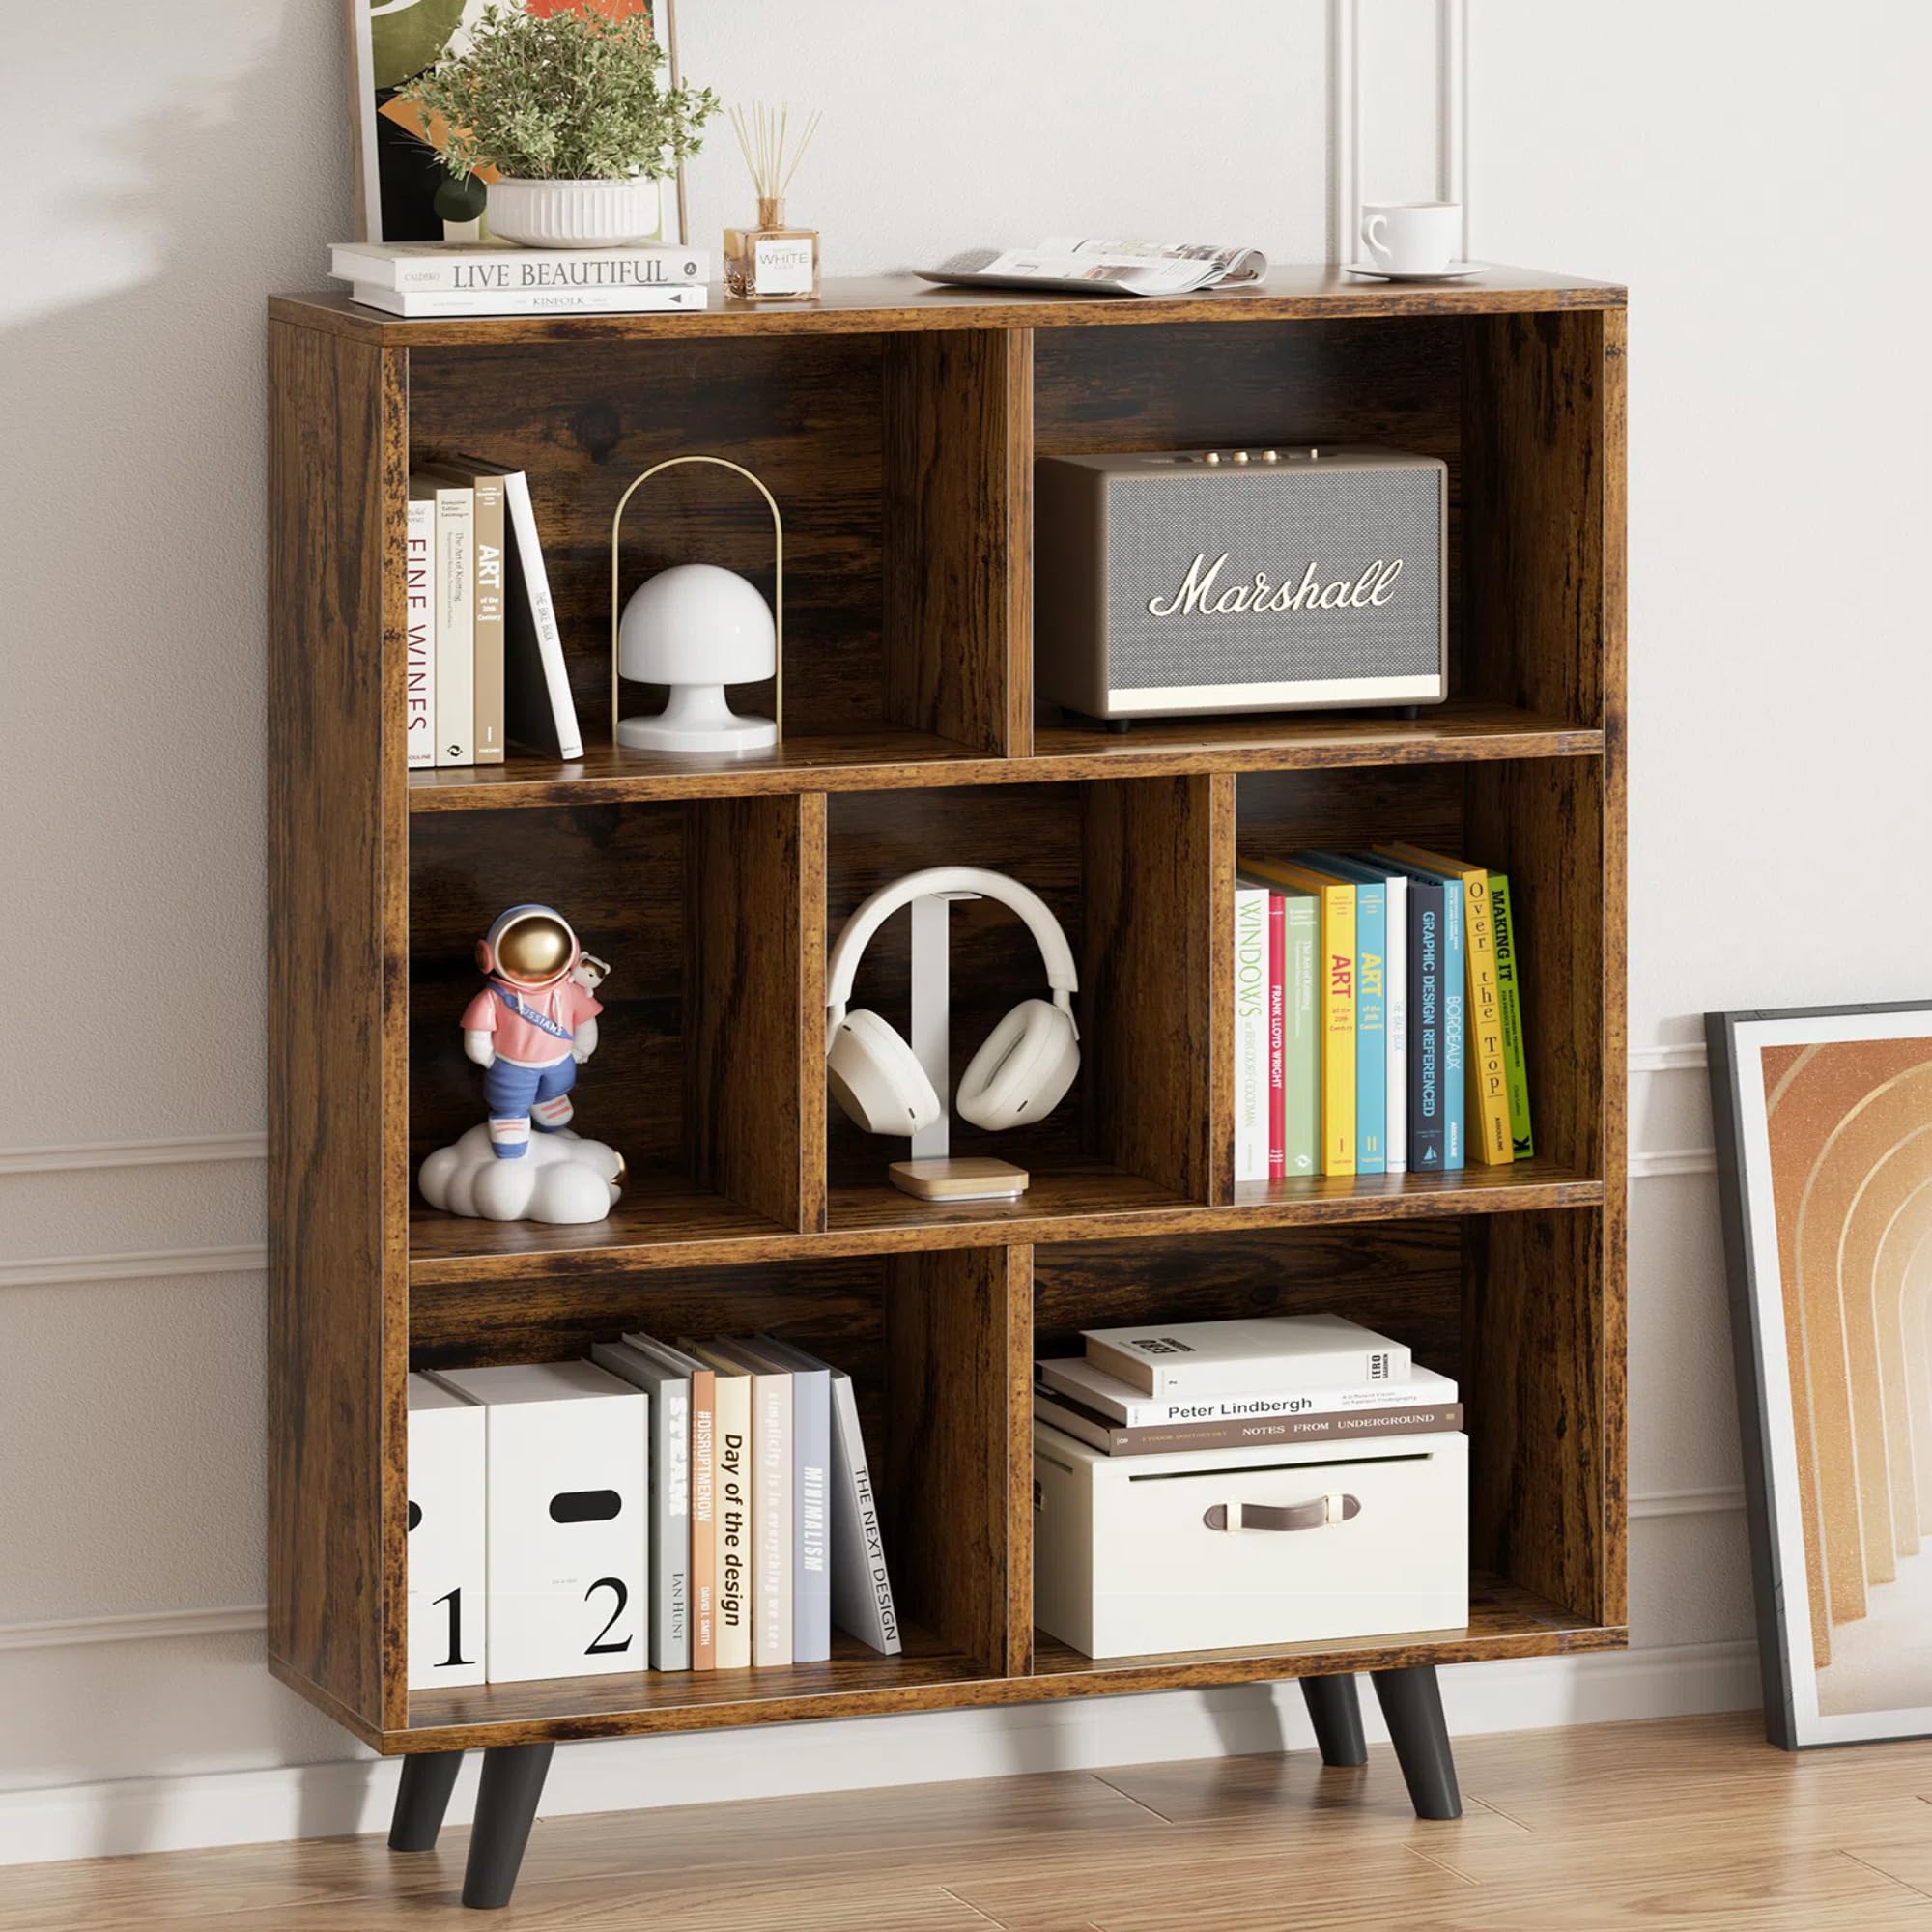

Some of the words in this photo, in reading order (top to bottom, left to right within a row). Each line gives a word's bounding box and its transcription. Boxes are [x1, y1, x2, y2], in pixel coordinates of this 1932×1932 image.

[453, 264, 510, 288] LIVE
[522, 260, 668, 286] BEAUTIFUL
[759, 253, 809, 264] WHITE
[533, 297, 584, 306] KINFOLK
[408, 539, 427, 609] FINE
[479, 544, 500, 589] ART
[1148, 552, 1404, 617] Marshall
[408, 624, 427, 731] WINES
[1422, 911, 1435, 972] GRAPHIC
[1492, 890, 1510, 960] MAKING
[1239, 899, 1262, 1018] WINDOWS
[1332, 954, 1351, 998] ART
[1360, 952, 1382, 998] ART
[1498, 964, 1513, 982] IT
[1272, 985, 1282, 1016] FRANK
[1422, 975, 1435, 1024] DESIGN
[1272, 1018, 1282, 1048] LLOYD
[1446, 996, 1461, 1070] BORDEAUX
[1272, 1050, 1282, 1089] WRIGHT
[1422, 1029, 1435, 1117] REFERENCED
[1371, 1354, 1381, 1379] EERO
[1168, 1406, 1215, 1419] Peter
[1221, 1398, 1312, 1415] Lindbergh
[1242, 1425, 1286, 1436] NOTES
[1293, 1422, 1330, 1433] FROM
[1337, 1413, 1435, 1429] UNDERGROUND
[697, 1410, 711, 1522] #DISRUPTMENOW
[721, 1434, 743, 1475] Day
[725, 1483, 744, 1506] of
[855, 1466, 872, 1504] THE
[725, 1512, 744, 1547] the
[804, 1466, 823, 1572] MINIMALISM
[863, 1510, 883, 1560] NEXT
[672, 1573, 684, 1597] IAN
[721, 1553, 743, 1627] design
[873, 1568, 897, 1641] DESIGN
[432, 1587, 476, 1667] 1
[583, 1577, 633, 1655] 2
[672, 1602, 684, 1640] HUNT
